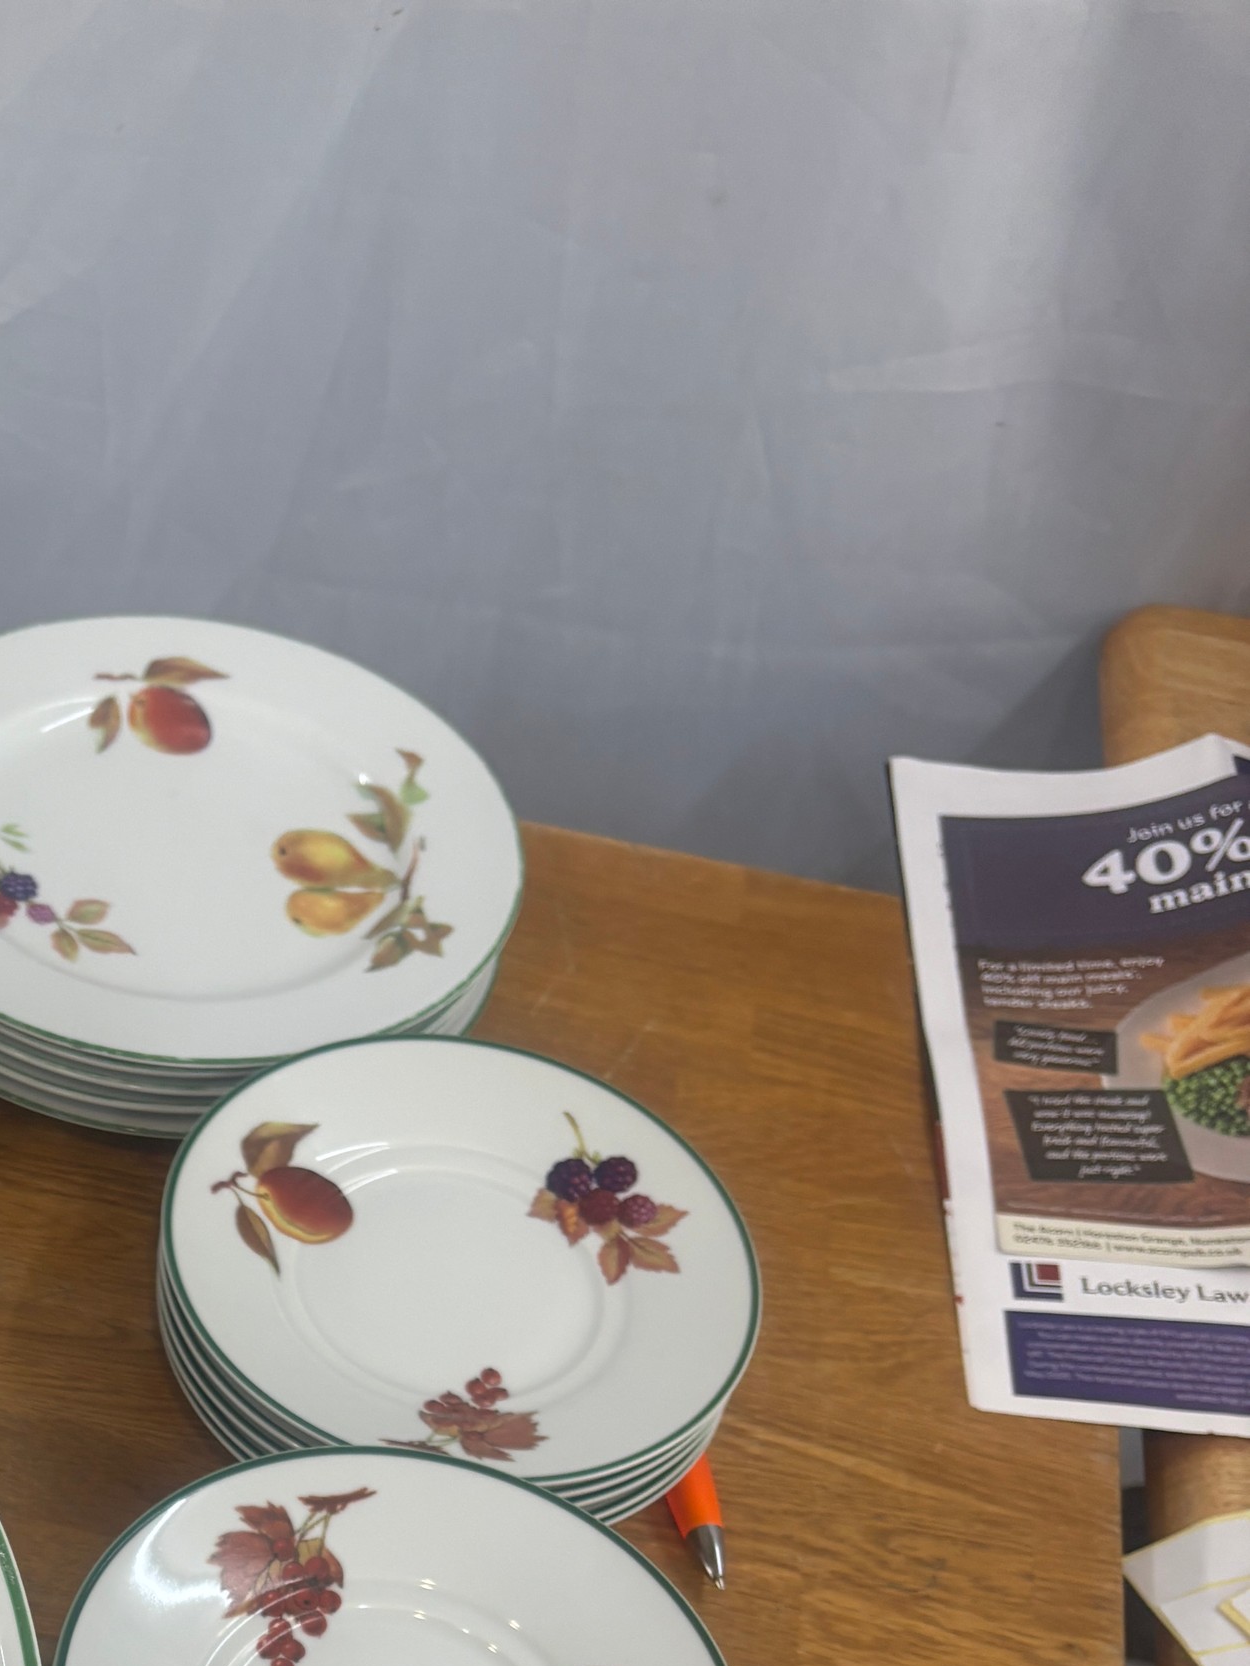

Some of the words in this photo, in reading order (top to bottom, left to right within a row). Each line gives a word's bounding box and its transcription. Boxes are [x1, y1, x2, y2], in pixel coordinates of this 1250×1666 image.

[1126, 822, 1174, 843] Join
[1177, 812, 1206, 831] us
[1208, 800, 1243, 820] for
[1081, 817, 1250, 895] 40%
[1080, 1275, 1190, 1303] Locksley
[1196, 1284, 1250, 1303] Law
